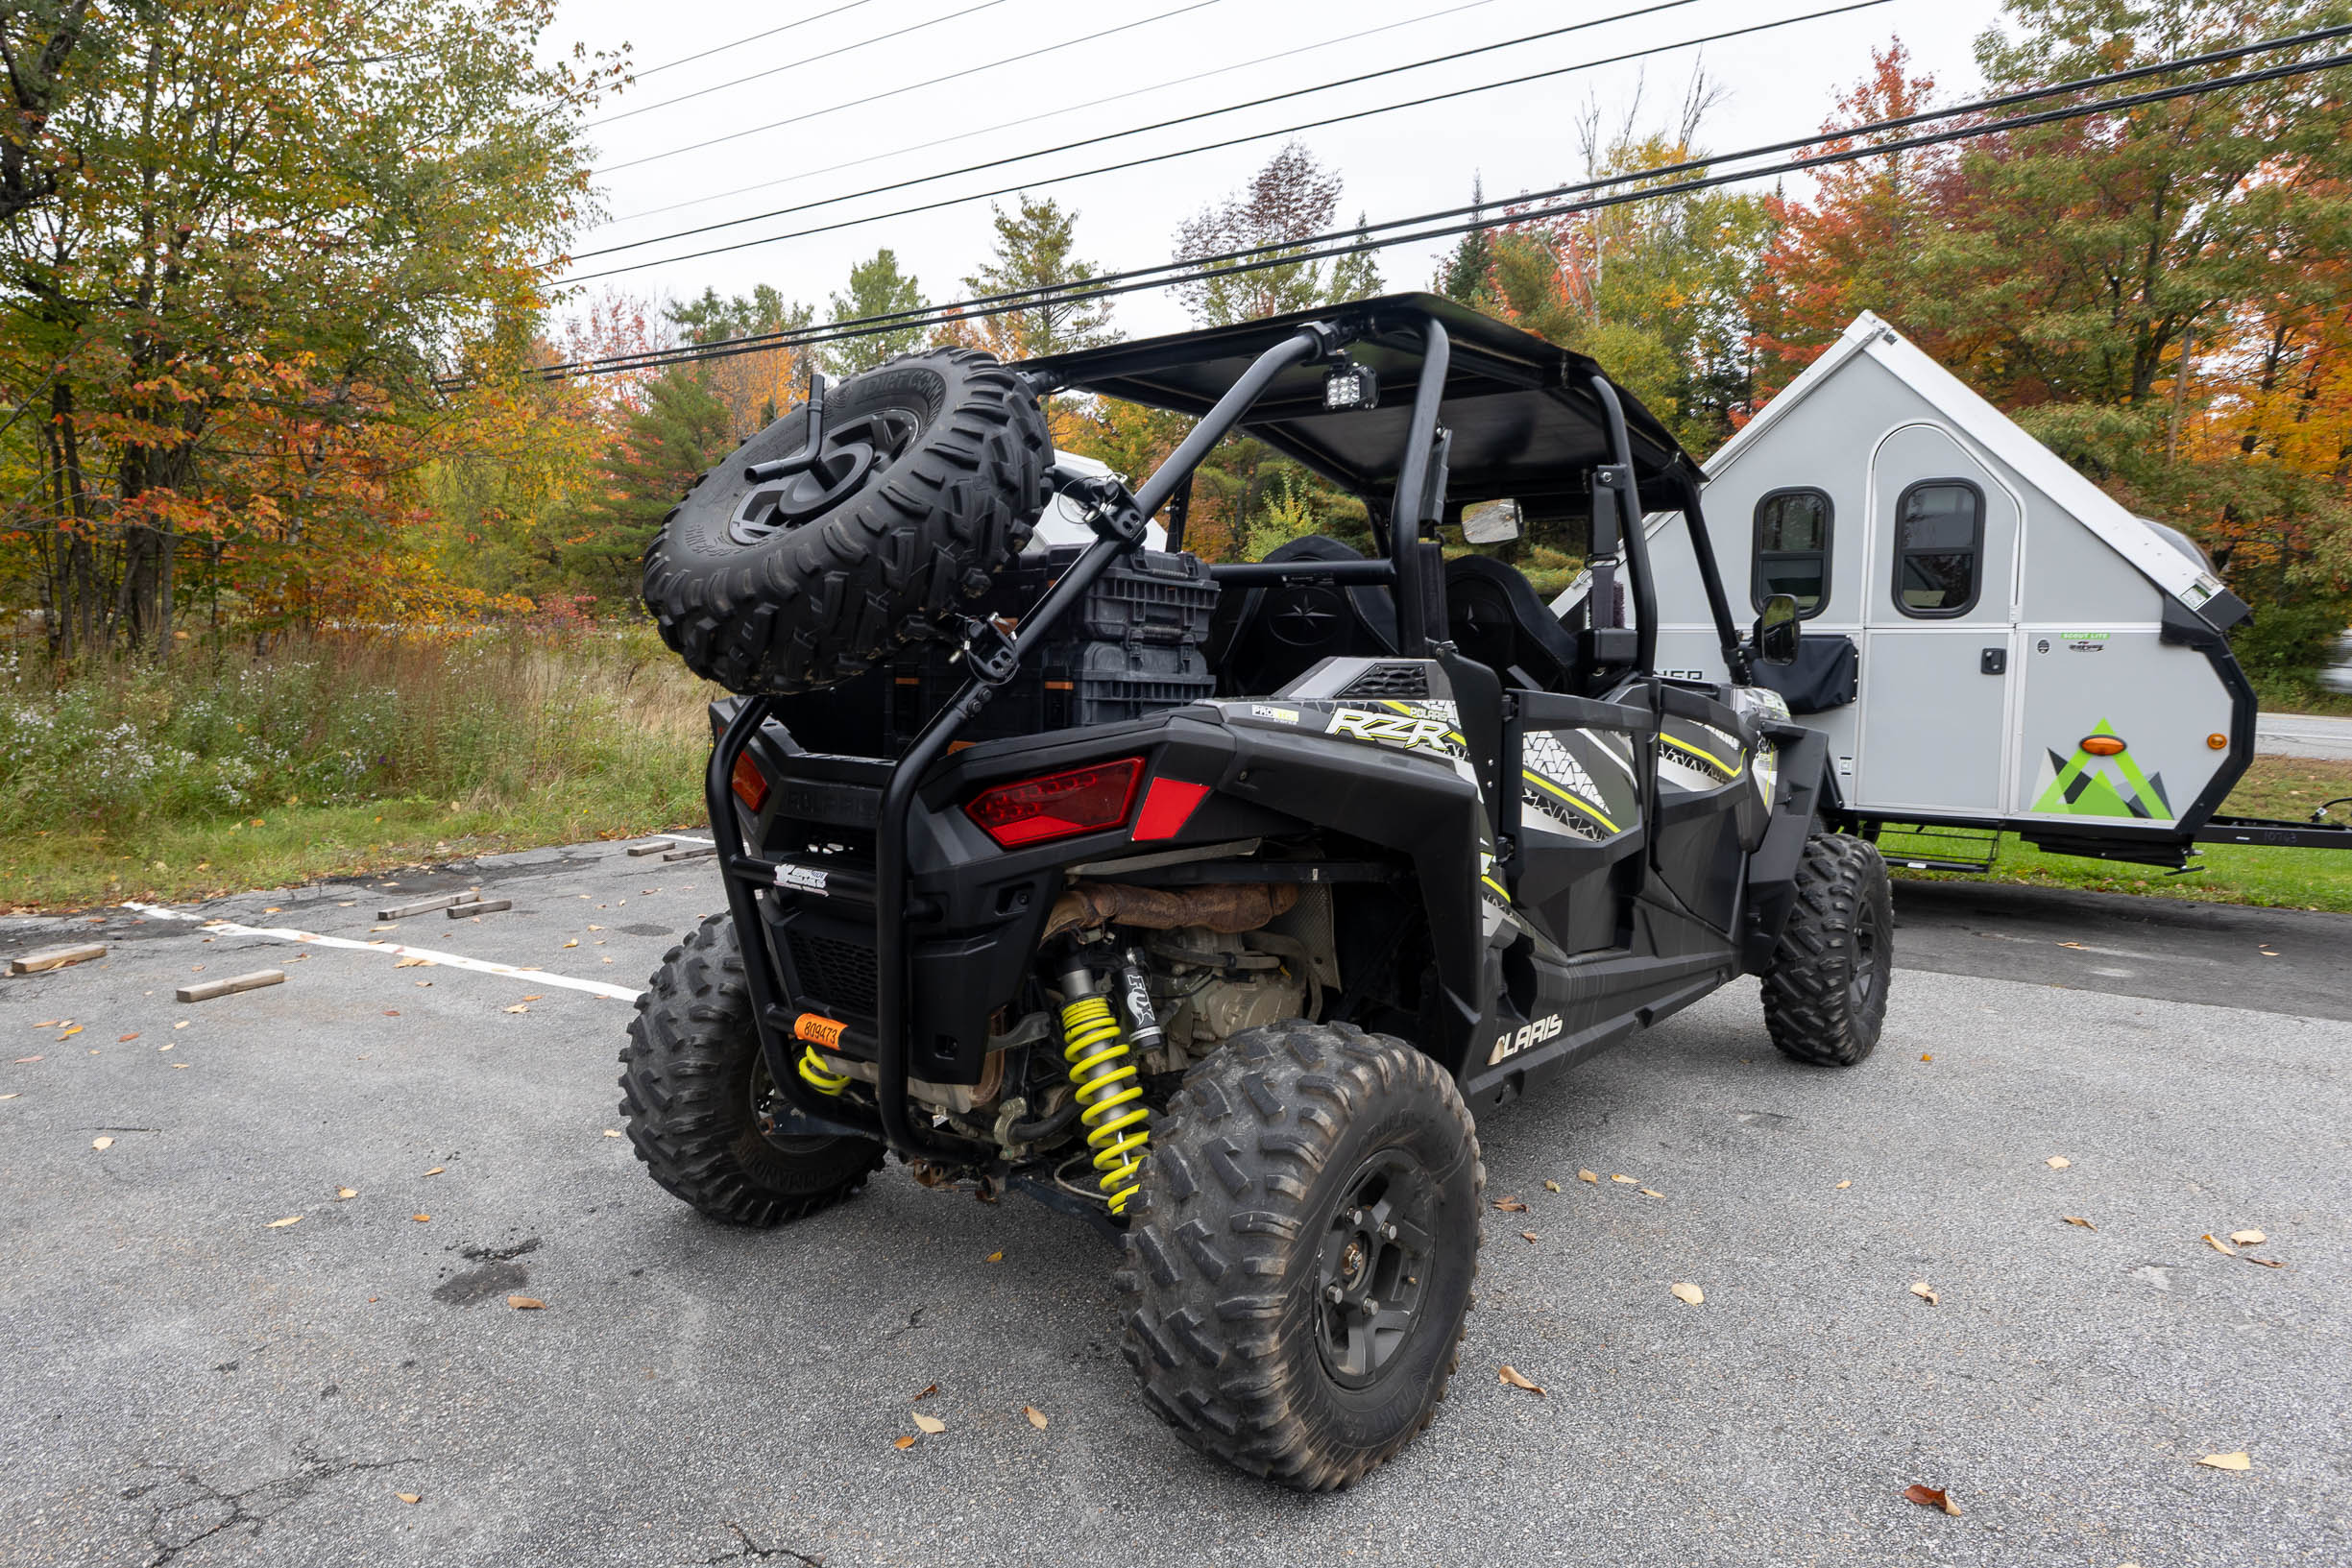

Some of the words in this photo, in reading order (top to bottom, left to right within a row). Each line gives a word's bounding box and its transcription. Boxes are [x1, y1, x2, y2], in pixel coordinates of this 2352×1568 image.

[1324, 707, 1452, 751] RZR
[1409, 706, 1448, 722] POLARIS
[1128, 974, 1156, 1026] FOX
[804, 1021, 838, 1045] 809473
